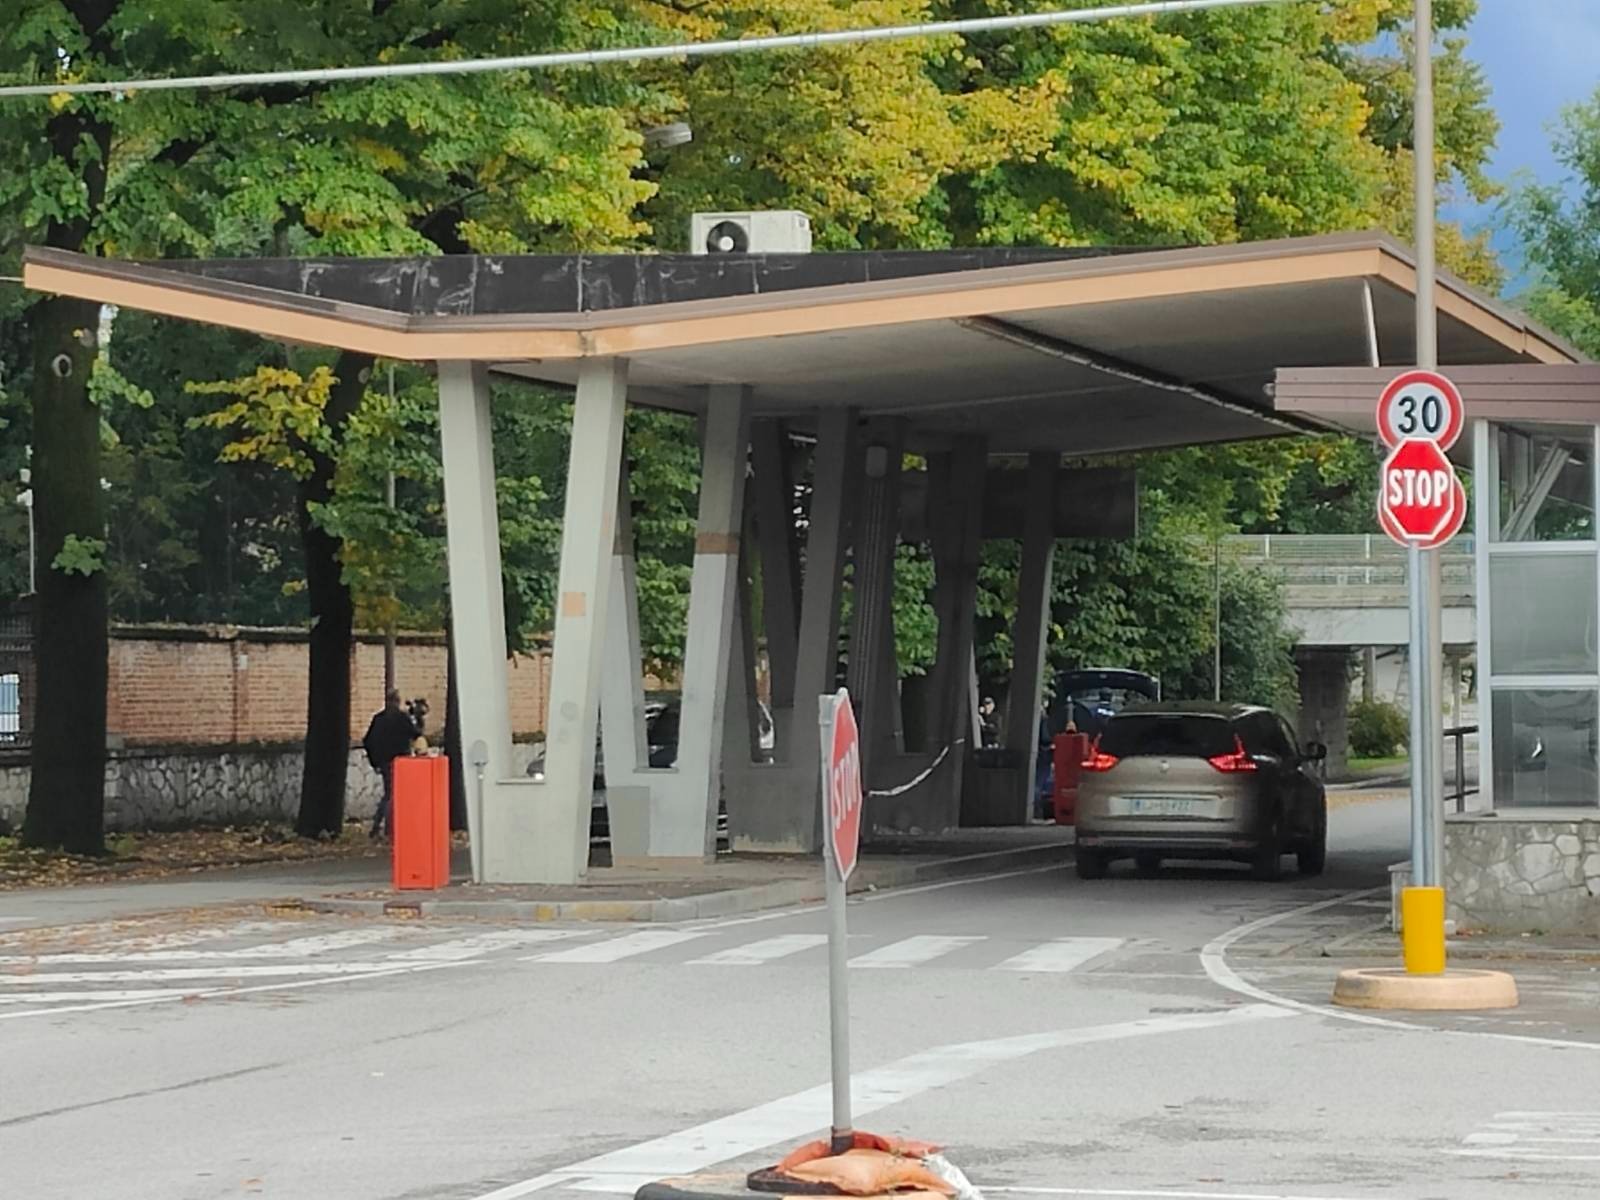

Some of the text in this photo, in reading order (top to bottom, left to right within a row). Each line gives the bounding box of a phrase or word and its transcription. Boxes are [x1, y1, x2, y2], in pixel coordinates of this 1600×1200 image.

[1398, 395, 1443, 434] 30
[1389, 468, 1448, 507] STOP
[833, 741, 860, 830] STOP
